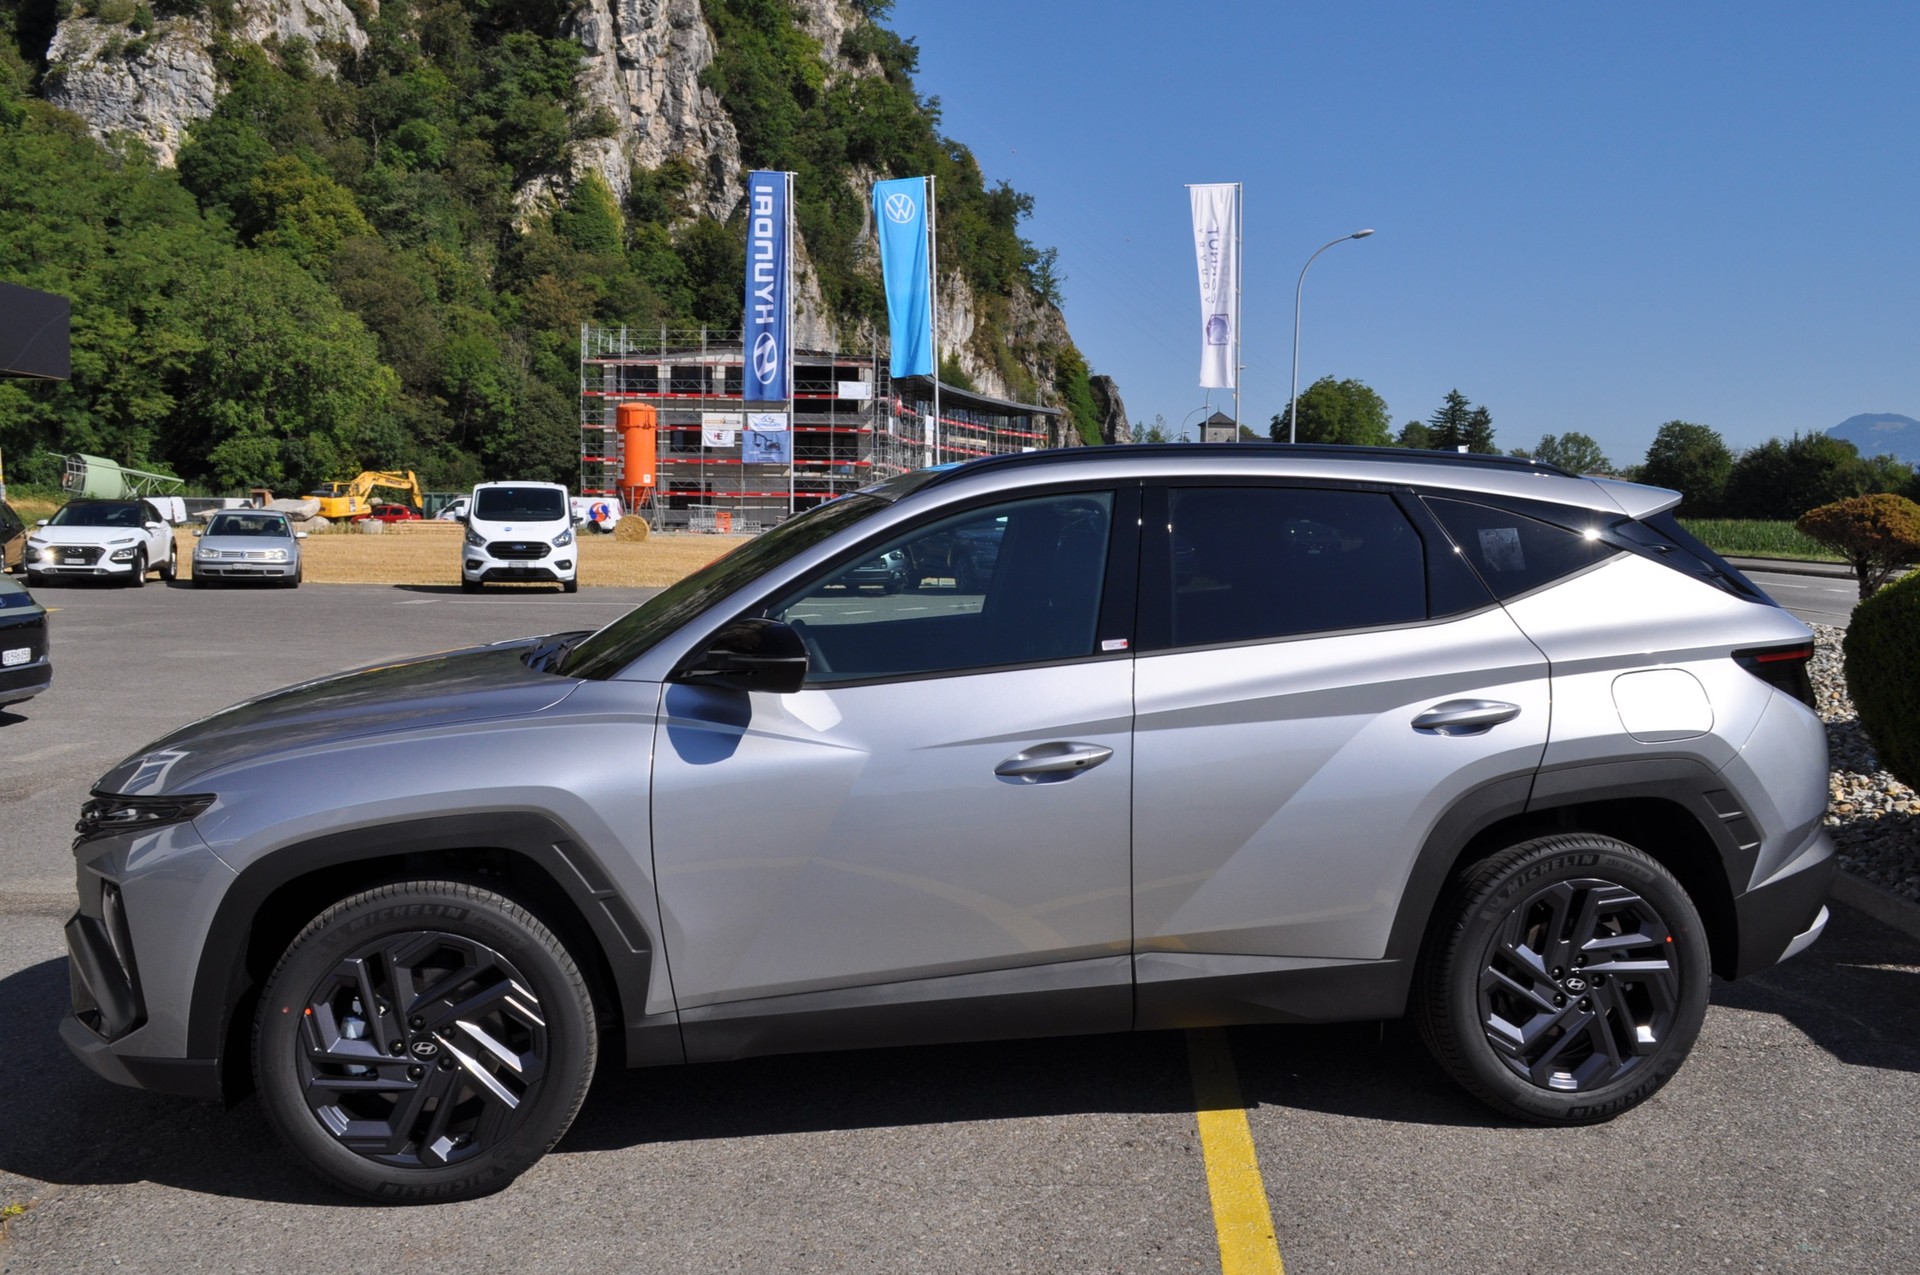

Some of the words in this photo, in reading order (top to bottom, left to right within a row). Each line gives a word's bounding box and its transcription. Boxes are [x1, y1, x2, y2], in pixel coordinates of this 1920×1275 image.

[1507, 854, 1595, 896] MICHELIN
[349, 903, 464, 933] MICHELIN
[382, 1168, 494, 1197] MICHELIN
